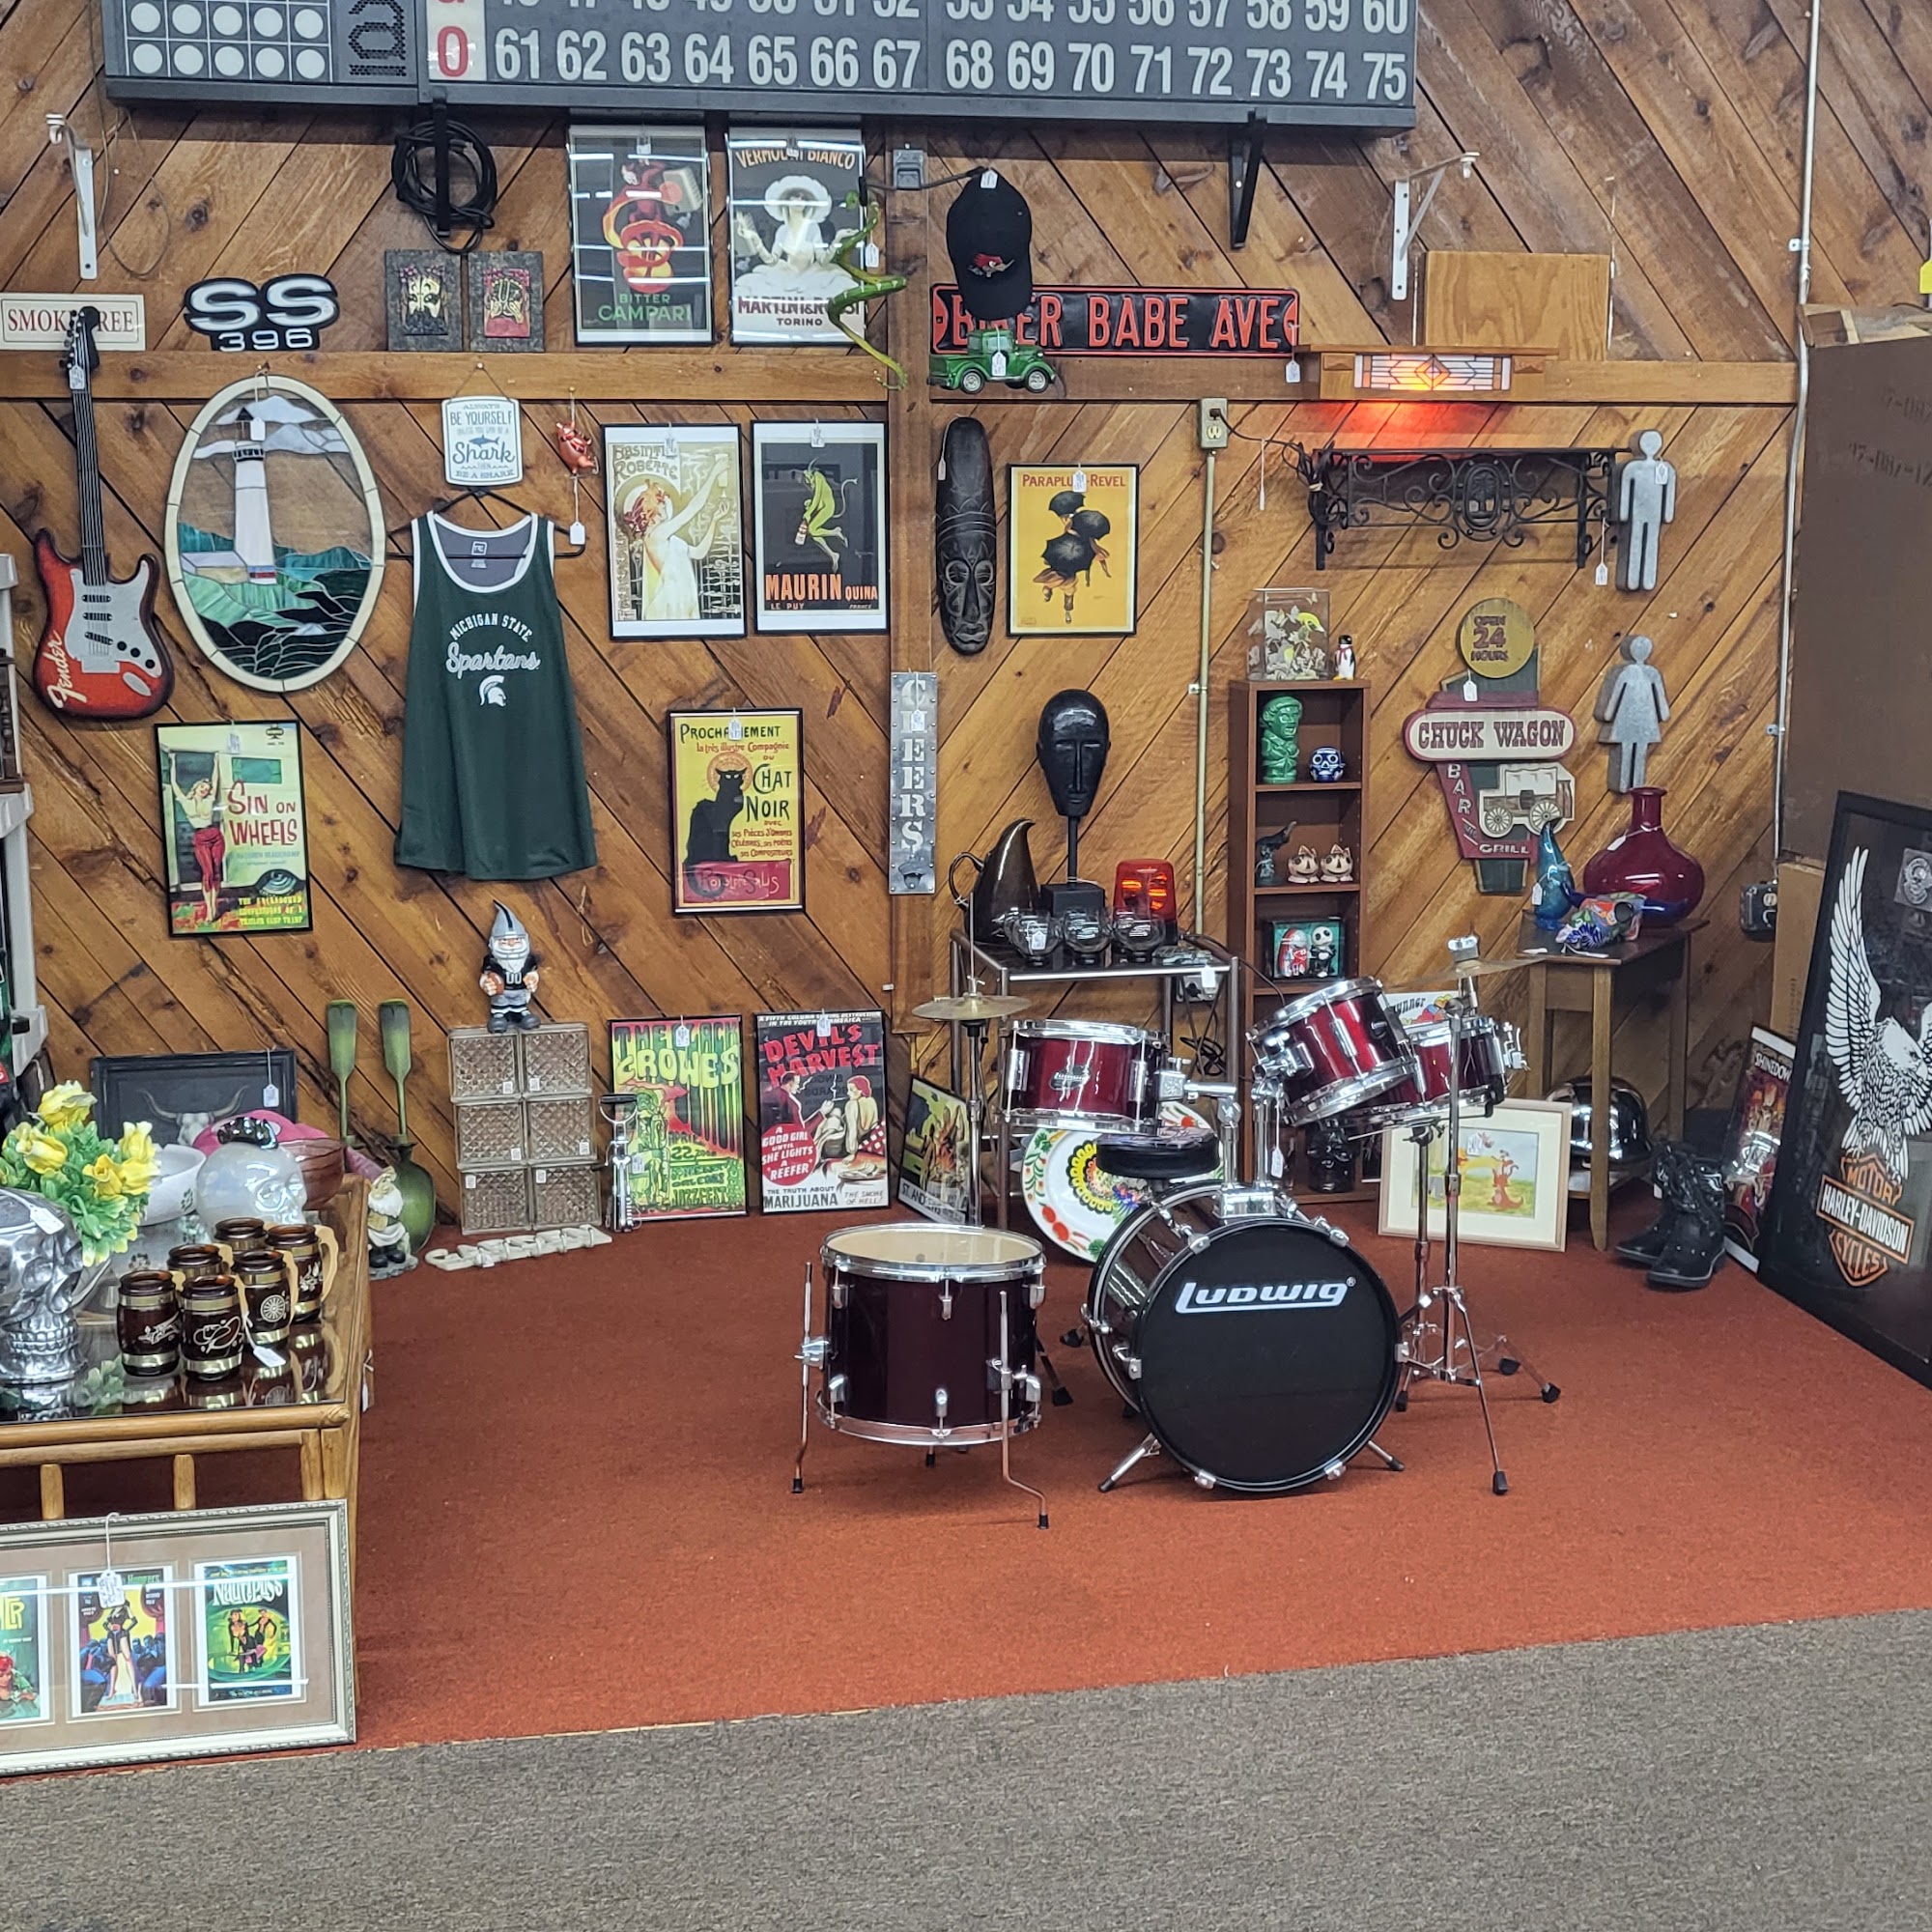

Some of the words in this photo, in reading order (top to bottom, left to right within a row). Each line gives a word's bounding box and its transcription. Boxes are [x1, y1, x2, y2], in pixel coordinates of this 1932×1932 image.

[1187, 0, 1232, 28] 57
[1246, 0, 1293, 30] 58
[1304, 0, 1350, 33] 59
[1362, 0, 1406, 34] 60
[495, 28, 540, 79] 61
[556, 30, 608, 81] 62
[621, 32, 671, 83] 63
[684, 34, 734, 84] 64
[748, 35, 797, 86] 65
[810, 37, 859, 87] 66
[873, 39, 921, 89] 67
[946, 39, 994, 90] 68
[1007, 40, 1055, 91] 69
[1068, 43, 1114, 93] 70
[1129, 44, 1172, 94] 71
[1187, 46, 1233, 96] 72
[1246, 48, 1292, 98] 73
[1306, 50, 1348, 99] 74
[1363, 52, 1406, 100] 75
[189, 276, 337, 331] SS
[619, 293, 670, 304] BITTER
[8, 309, 75, 332] SMOK
[95, 310, 135, 332] REE
[598, 304, 692, 322] CAMPARI
[777, 318, 823, 327] TORINO
[952, 295, 1062, 347] BER
[1088, 297, 1189, 349] BABE
[1210, 298, 1280, 349] AVE
[218, 328, 314, 353] 396
[450, 412, 462, 425] BE
[466, 411, 512, 425] YOURSELF
[452, 440, 515, 464] Shark
[614, 460, 678, 480] ROBETTE
[765, 574, 841, 601] MAURIN
[845, 585, 878, 601] QUINA
[450, 613, 498, 640] MICHIGAN
[501, 615, 532, 642] STATE
[1474, 615, 1506, 626] OPEN
[1473, 627, 1506, 648] 24
[445, 641, 541, 679] Spartans
[1471, 650, 1508, 662] HOURS
[43, 631, 88, 709] Fender
[748, 742, 789, 753] Compagnie
[1418, 722, 1484, 750] CHUCK
[1494, 720, 1565, 748] WAGON
[753, 764, 792, 794] CHAT
[1448, 763, 1471, 814] BAR
[228, 780, 268, 814] SIN
[275, 802, 296, 813] ON
[747, 796, 789, 822] NOIR
[229, 819, 298, 846] WHEELS
[1479, 844, 1529, 854] GRILL
[615, 1045, 740, 1089] CROWES
[767, 1044, 879, 1088] HARVEST
[671, 1146, 694, 1159] 22
[762, 1134, 788, 1148] GOOD
[790, 1131, 808, 1141] GIRL
[762, 1152, 779, 1165] SHE
[781, 1147, 813, 1159] LIGHTS
[771, 1163, 809, 1180] REEFER
[1847, 1162, 1892, 1206] MOTOR
[764, 1193, 838, 1208] MARIJUANA
[1821, 1183, 1910, 1255] HARLEY-DAVIDSON
[1836, 1232, 1881, 1278] CYCLES
